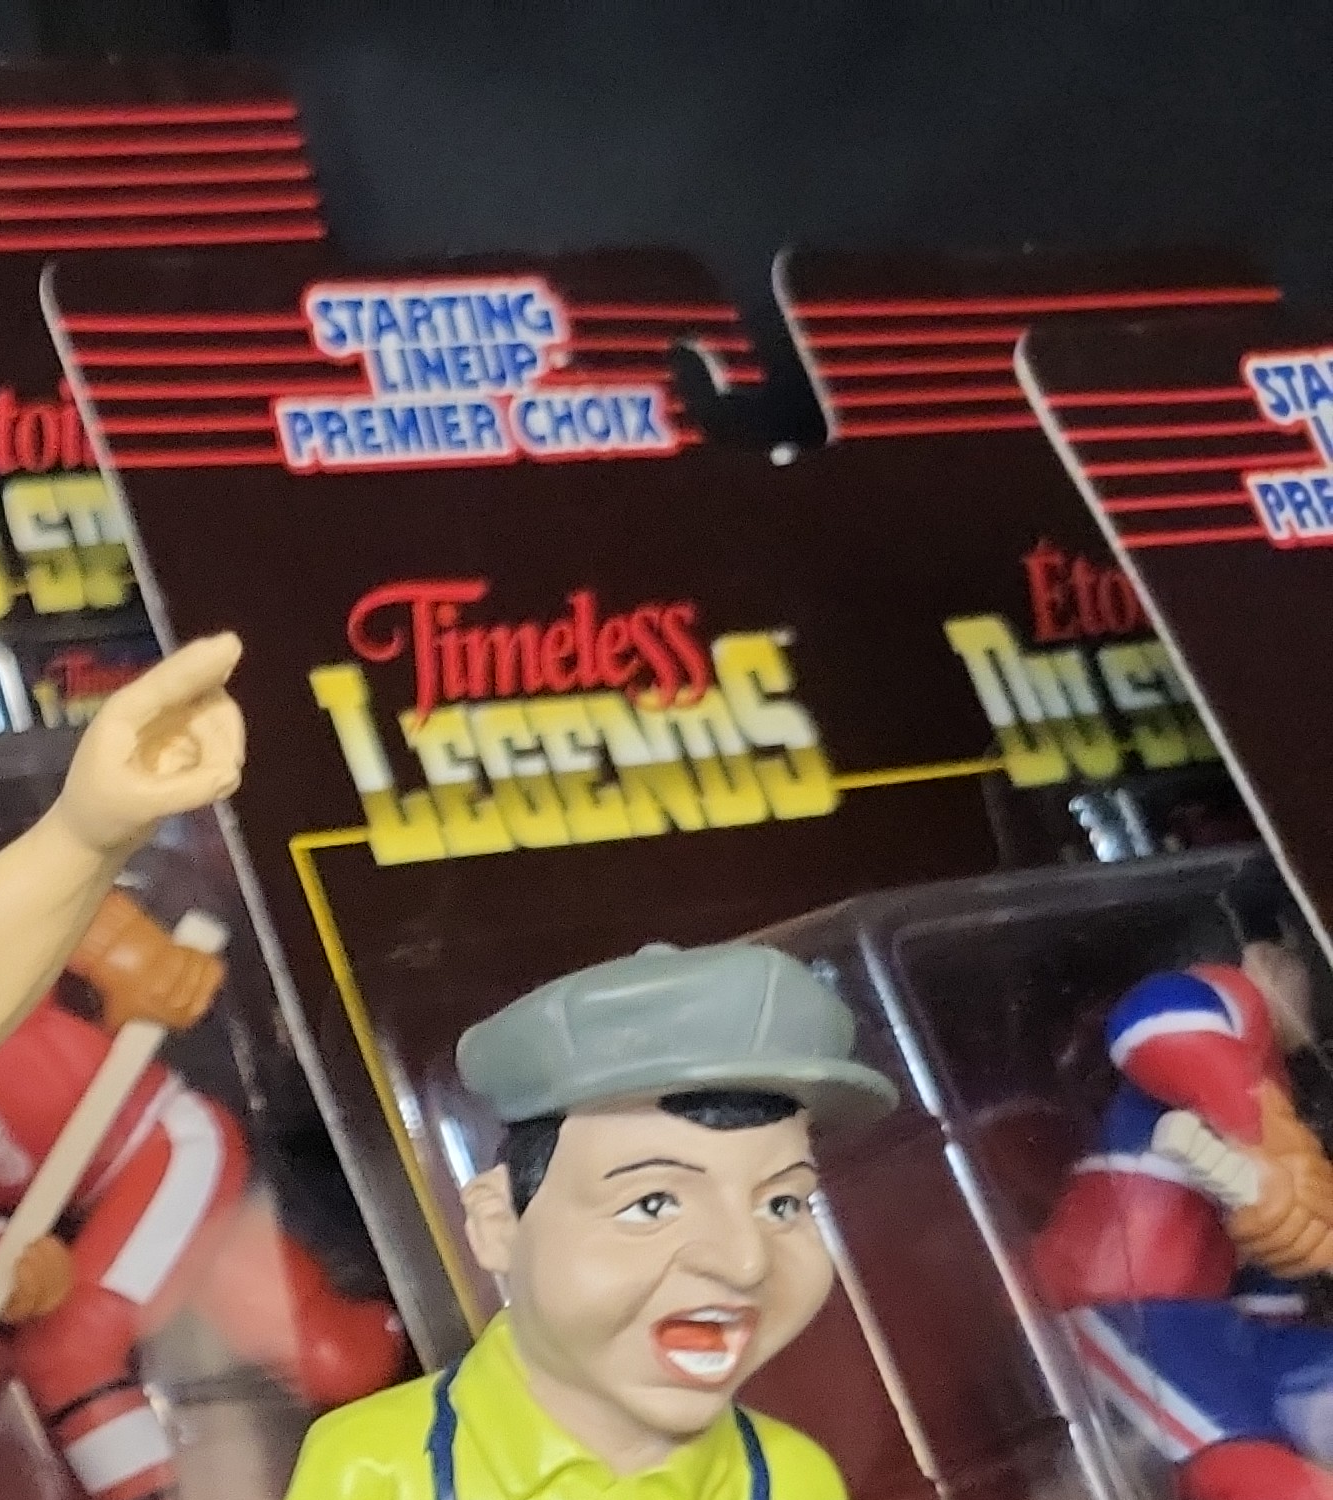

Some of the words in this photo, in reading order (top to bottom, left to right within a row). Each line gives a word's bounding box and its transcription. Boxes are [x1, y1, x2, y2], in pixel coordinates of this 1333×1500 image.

[315, 291, 555, 347] STARTING
[377, 341, 539, 396] LINEUP
[285, 401, 504, 460] PREMIER
[522, 395, 664, 446] CHOIX
[347, 577, 716, 735] Timeless
[308, 632, 837, 867] LEGENDS
